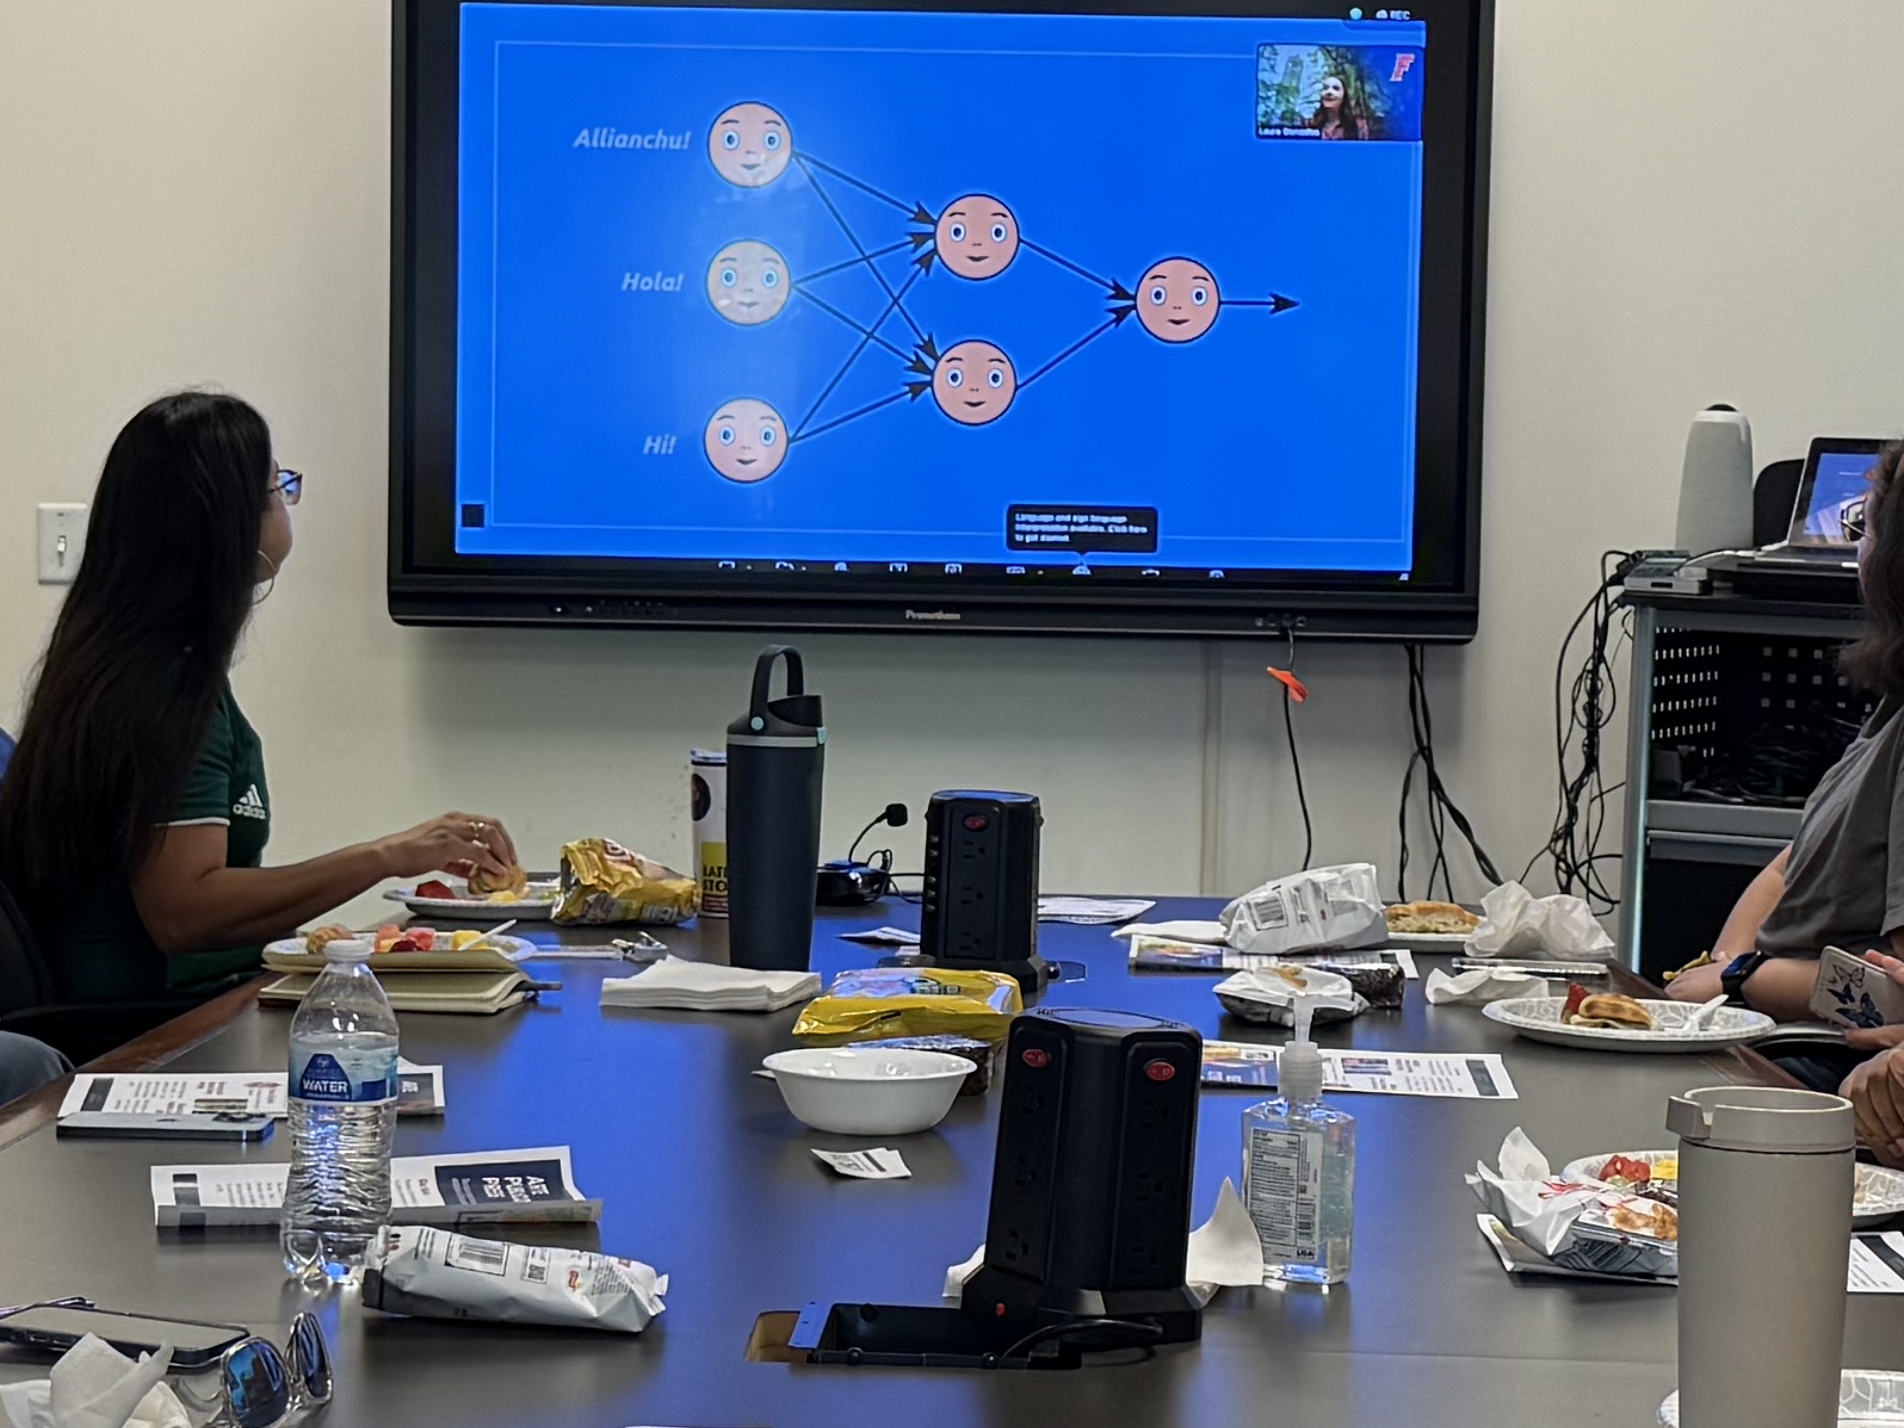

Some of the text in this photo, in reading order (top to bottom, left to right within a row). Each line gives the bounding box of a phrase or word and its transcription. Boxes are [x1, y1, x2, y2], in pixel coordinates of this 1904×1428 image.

[573, 128, 691, 150] Allianchu!
[622, 272, 684, 292] Hola!
[643, 436, 677, 455] Hi!
[303, 1078, 348, 1093] WATER
